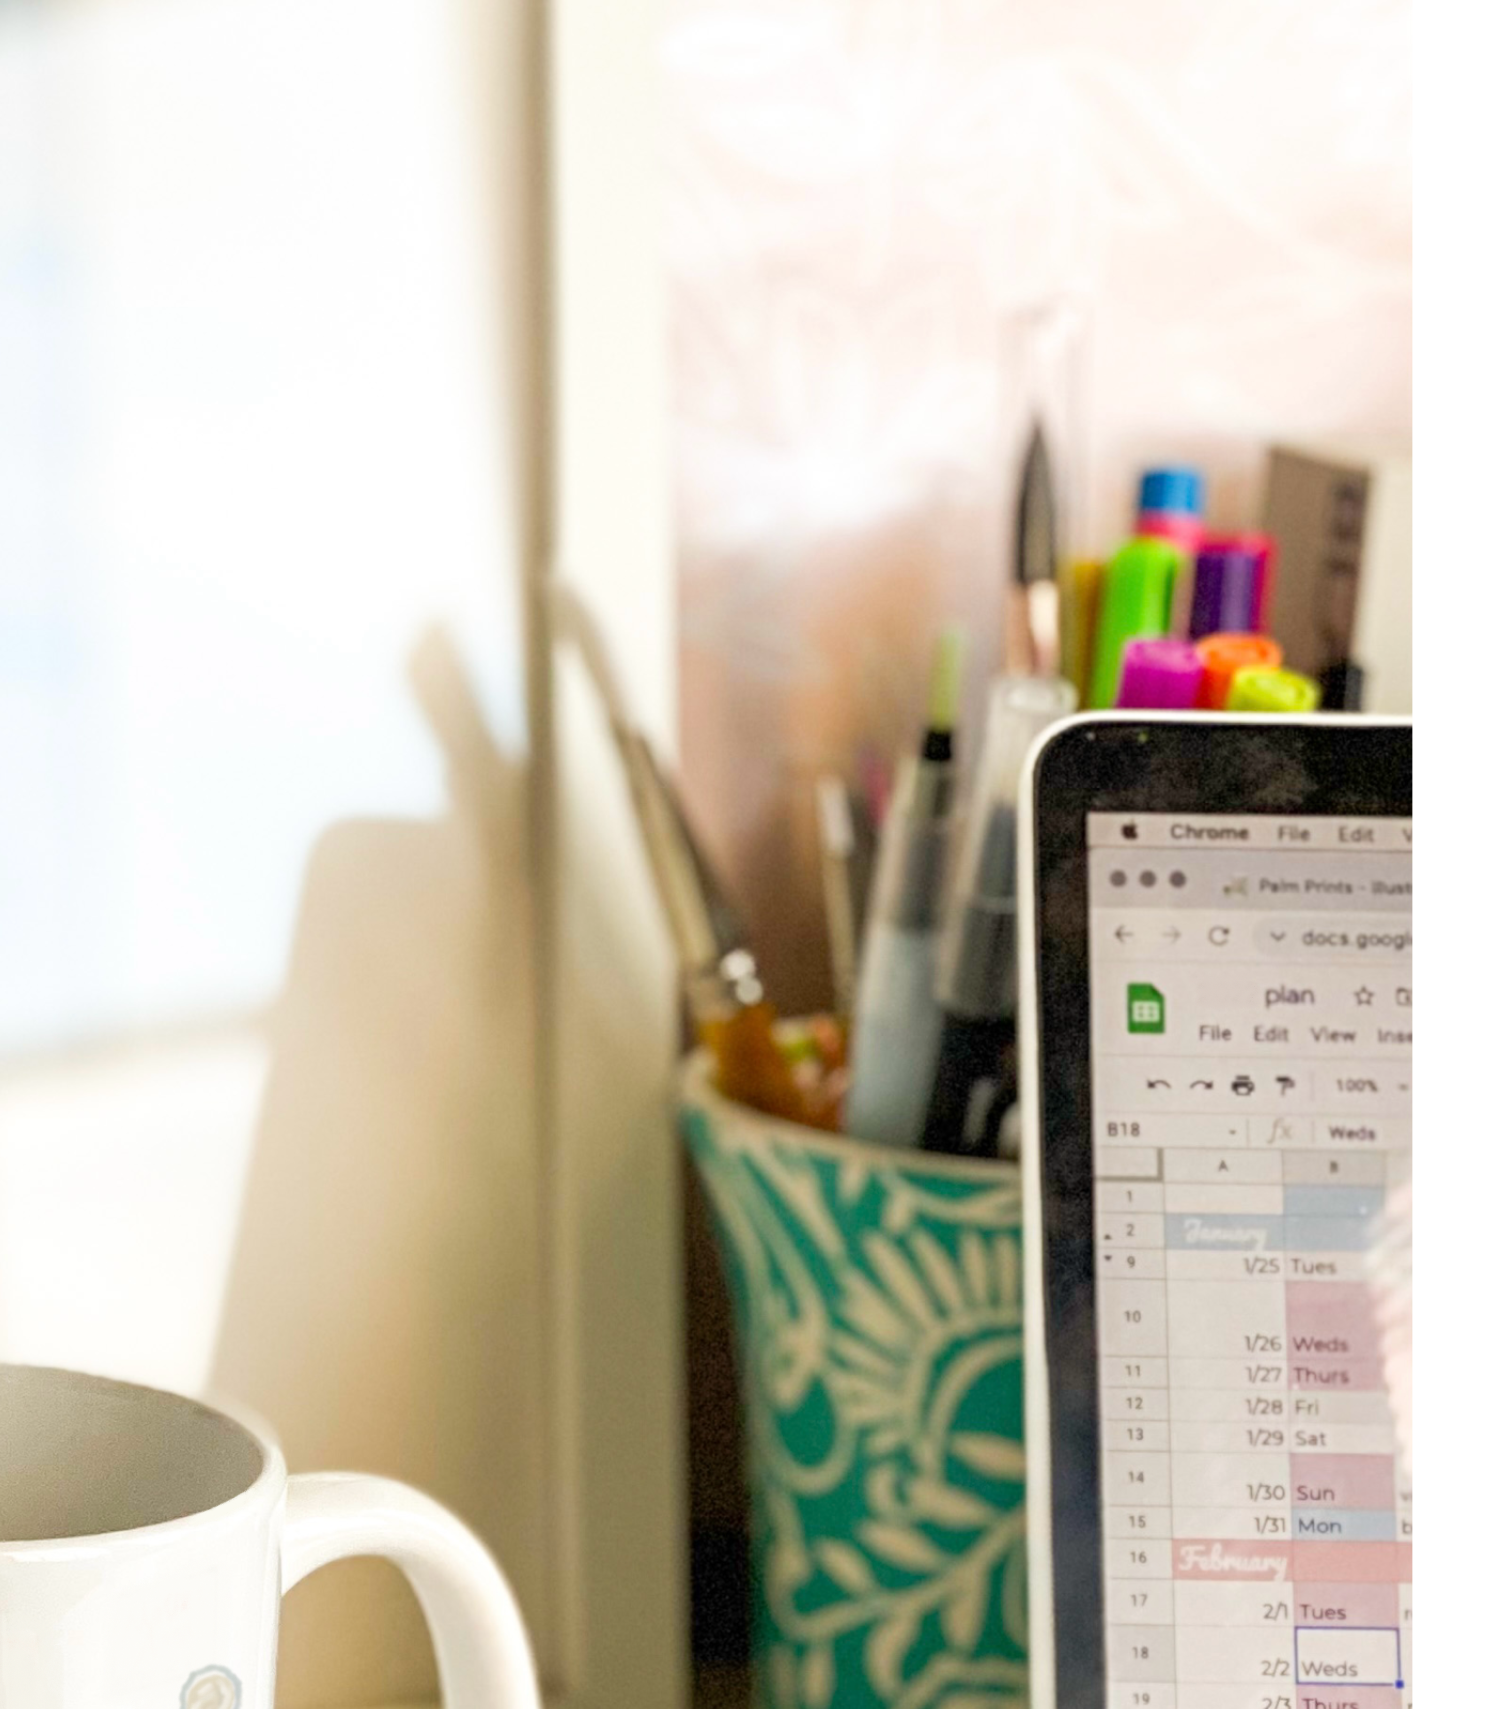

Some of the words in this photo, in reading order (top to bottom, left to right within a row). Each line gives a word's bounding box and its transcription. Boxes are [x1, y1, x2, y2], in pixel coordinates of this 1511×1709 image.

[1171, 824, 1249, 840] Chrome
[1278, 826, 1310, 841] File
[1339, 826, 1374, 842] Edit
[1259, 878, 1299, 894] Palm
[1304, 879, 1352, 894] Prints
[1302, 930, 1412, 950] docs.googl
[1265, 986, 1315, 1007] plan
[1199, 1025, 1232, 1041] File
[1253, 1026, 1289, 1042] Edit
[1311, 1027, 1356, 1043] View
[1337, 1078, 1378, 1093] 100%
[1107, 1122, 1141, 1137] B18
[1328, 1126, 1376, 1141] Weds
[1218, 1160, 1228, 1172] A
[1330, 1161, 1338, 1173] B
[1126, 1191, 1132, 1202] 1
[1126, 1225, 1135, 1237] 2
[1184, 1218, 1268, 1250] January
[1127, 1257, 1136, 1268] 9
[1244, 1258, 1280, 1274] 1/25
[1291, 1259, 1337, 1275] Tues
[1124, 1311, 1141, 1323] 10
[1245, 1335, 1281, 1352] 1/26
[1293, 1336, 1349, 1352] Weds
[1125, 1365, 1141, 1377] 11
[1245, 1366, 1282, 1382] 1/27
[1294, 1367, 1349, 1384] Thurs
[1126, 1398, 1143, 1410] 12
[1246, 1398, 1283, 1415] 1/28
[1295, 1399, 1320, 1415] Fri
[1127, 1429, 1144, 1441] 13
[1247, 1429, 1284, 1446] 1/29
[1295, 1430, 1327, 1447] Sat
[1128, 1472, 1145, 1484] 14
[1247, 1484, 1285, 1501] 1/30
[1297, 1486, 1335, 1501] Sun
[1129, 1516, 1146, 1528] 15
[1255, 1517, 1286, 1533] 1/31
[1298, 1518, 1342, 1534] Mon
[1130, 1552, 1147, 1564] 16
[1178, 1543, 1288, 1582] February
[1130, 1595, 1148, 1606] 17
[1263, 1603, 1289, 1621] 2/1
[1299, 1604, 1347, 1620] Tues
[1132, 1647, 1148, 1659] 18
[1261, 1660, 1290, 1677] 2/2
[1301, 1661, 1358, 1677] Weds
[1133, 1693, 1150, 1705] 19
